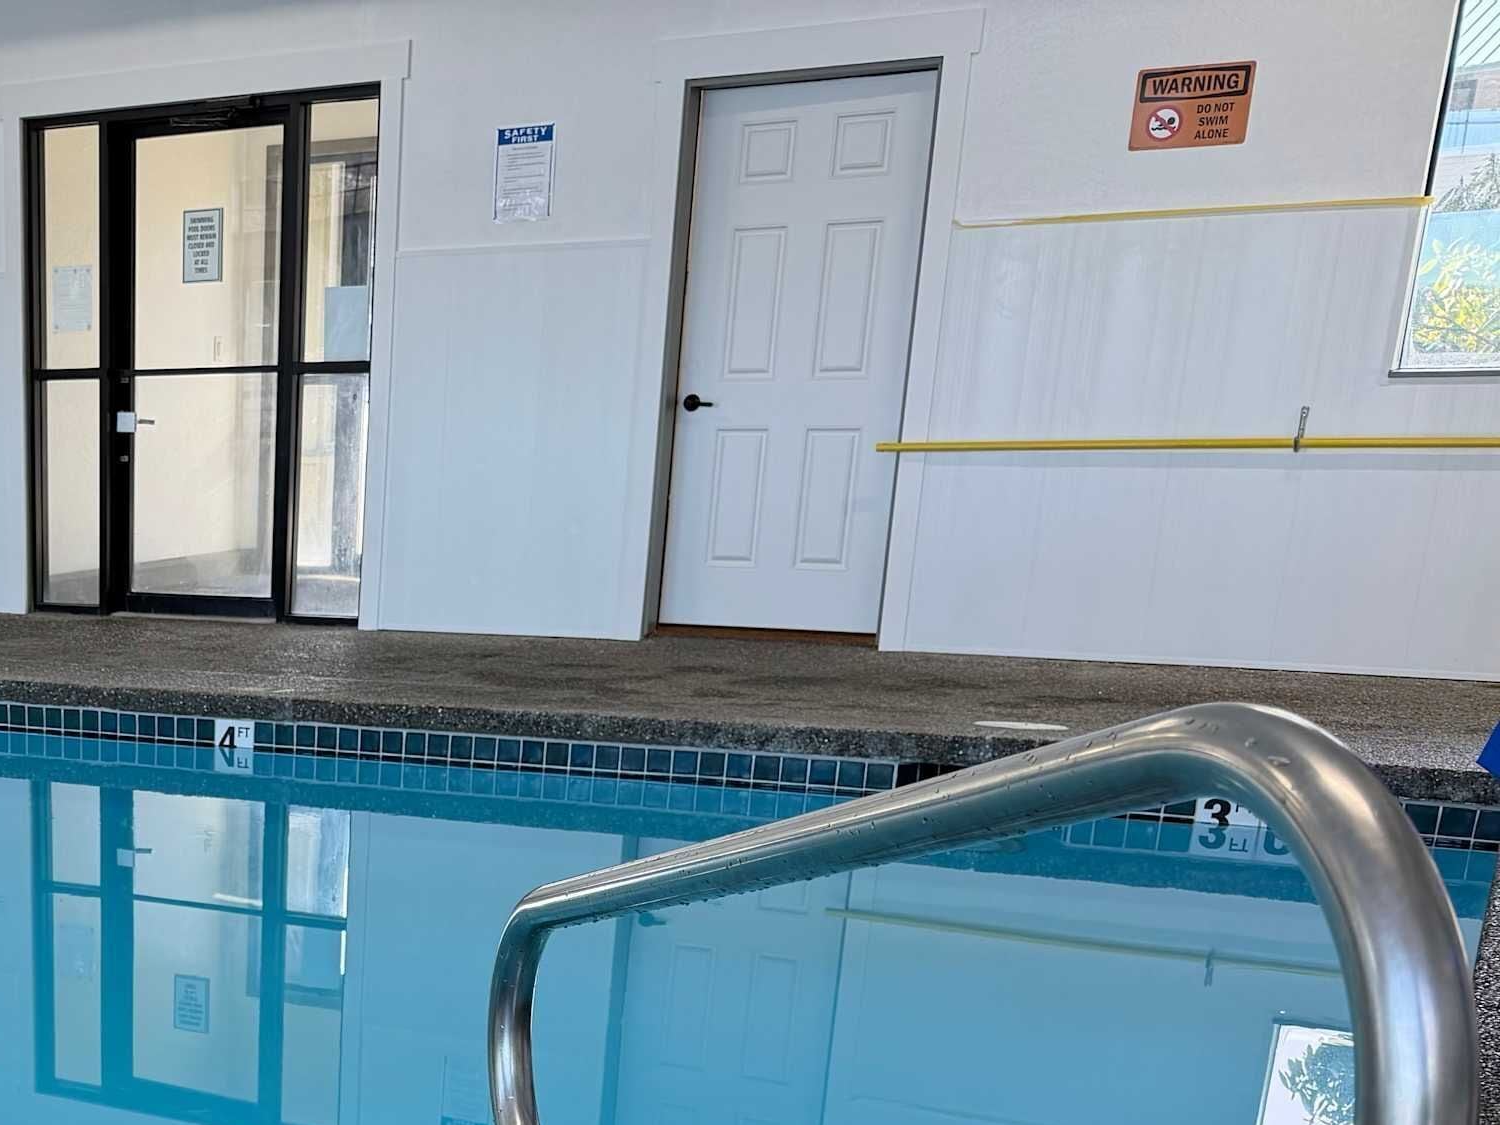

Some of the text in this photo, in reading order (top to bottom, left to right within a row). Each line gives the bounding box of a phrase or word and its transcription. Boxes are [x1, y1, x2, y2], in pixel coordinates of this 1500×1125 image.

[1152, 73, 1240, 95] WARNING
[1197, 102, 1235, 114] DO NOT
[1198, 116, 1229, 127] SWIM
[504, 126, 548, 140] SAFETY
[512, 135, 539, 143] FIRST
[1195, 128, 1229, 140] ALONE
[219, 726, 250, 749] 4 FT
[1204, 798, 1231, 826] 3
